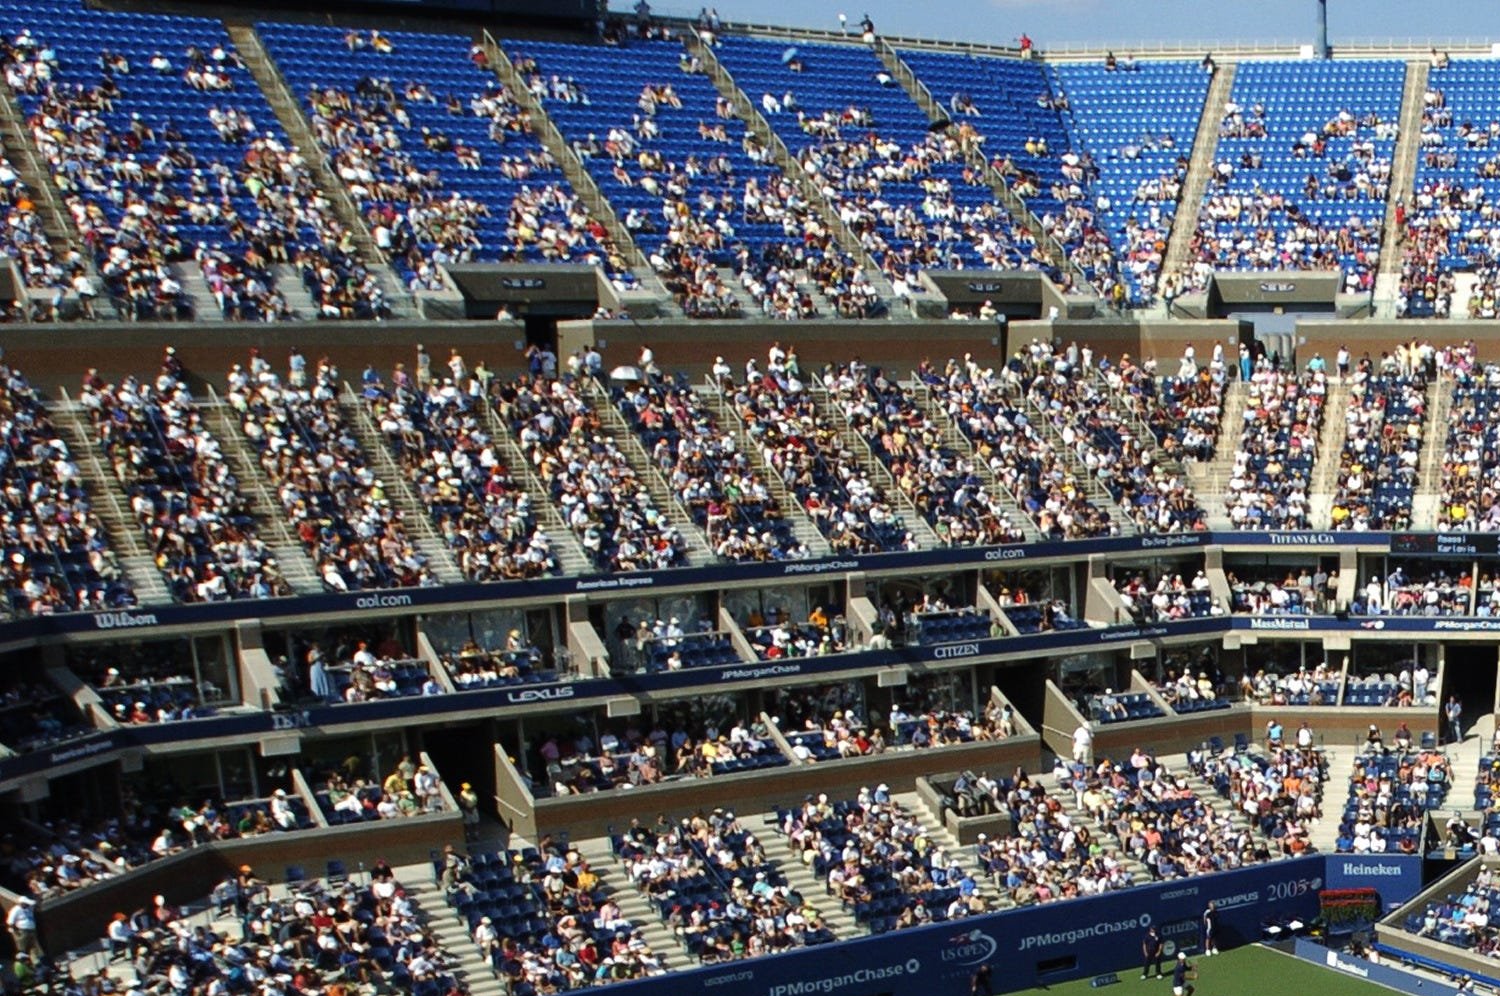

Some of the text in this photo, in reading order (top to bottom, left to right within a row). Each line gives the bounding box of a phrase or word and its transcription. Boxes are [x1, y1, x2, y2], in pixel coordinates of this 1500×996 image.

[985, 548, 1025, 560] aol.com
[784, 561, 859, 574] JPMorganChase
[576, 576, 653, 590] American Express
[356, 594, 412, 609] aol.com
[94, 611, 158, 629] Wilson
[1251, 618, 1309, 629] MassMutual
[1100, 629, 1140, 640] Continental
[934, 643, 980, 659] CITIZEN
[721, 665, 801, 680] JPMorganChase
[507, 686, 574, 703] LEXUS
[1343, 863, 1401, 875] Heineken
[1211, 879, 1308, 908] LYMPUS 2005
[1018, 919, 1137, 950] JPMorganChase
[1161, 920, 1199, 936] CITIZEN
[941, 942, 989, 961] US OPEN
[704, 970, 753, 987] usopen.org
